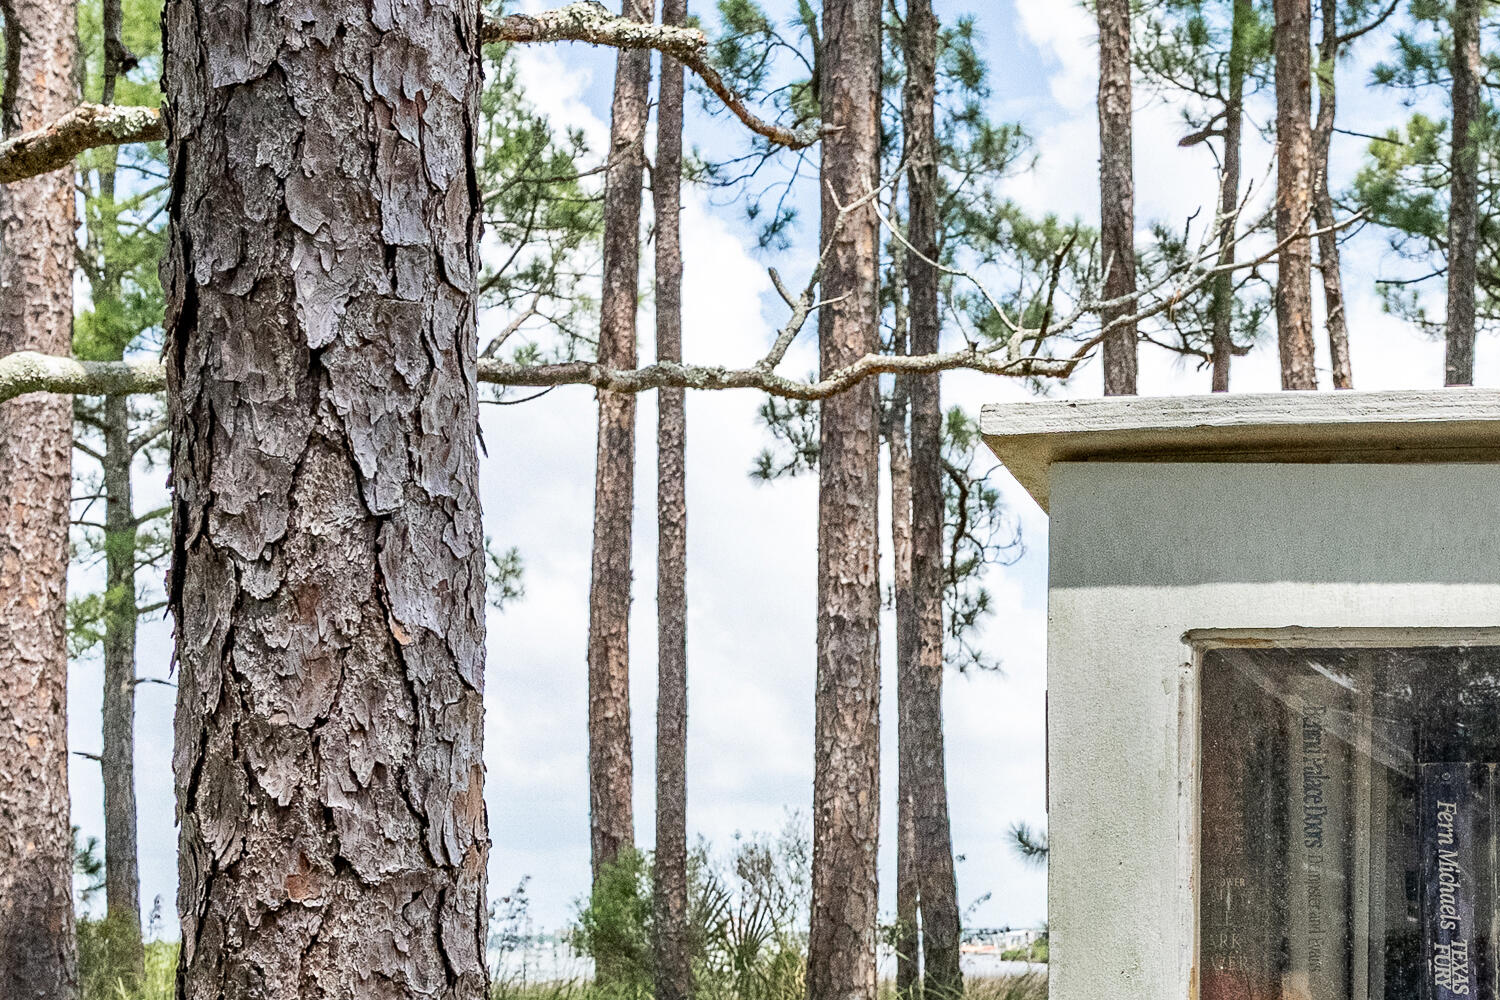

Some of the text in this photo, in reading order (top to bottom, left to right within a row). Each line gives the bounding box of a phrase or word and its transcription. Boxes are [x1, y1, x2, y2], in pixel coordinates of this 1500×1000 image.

[1303, 705, 1328, 753] Behind
[1302, 757, 1330, 805] Palace
[1303, 806, 1328, 848] Doors
[1436, 801, 1461, 930] Fern Michaels
[1309, 938, 1323, 973] Evans
[1434, 942, 1452, 990] FURY
[1451, 939, 1469, 995] TEXAS
